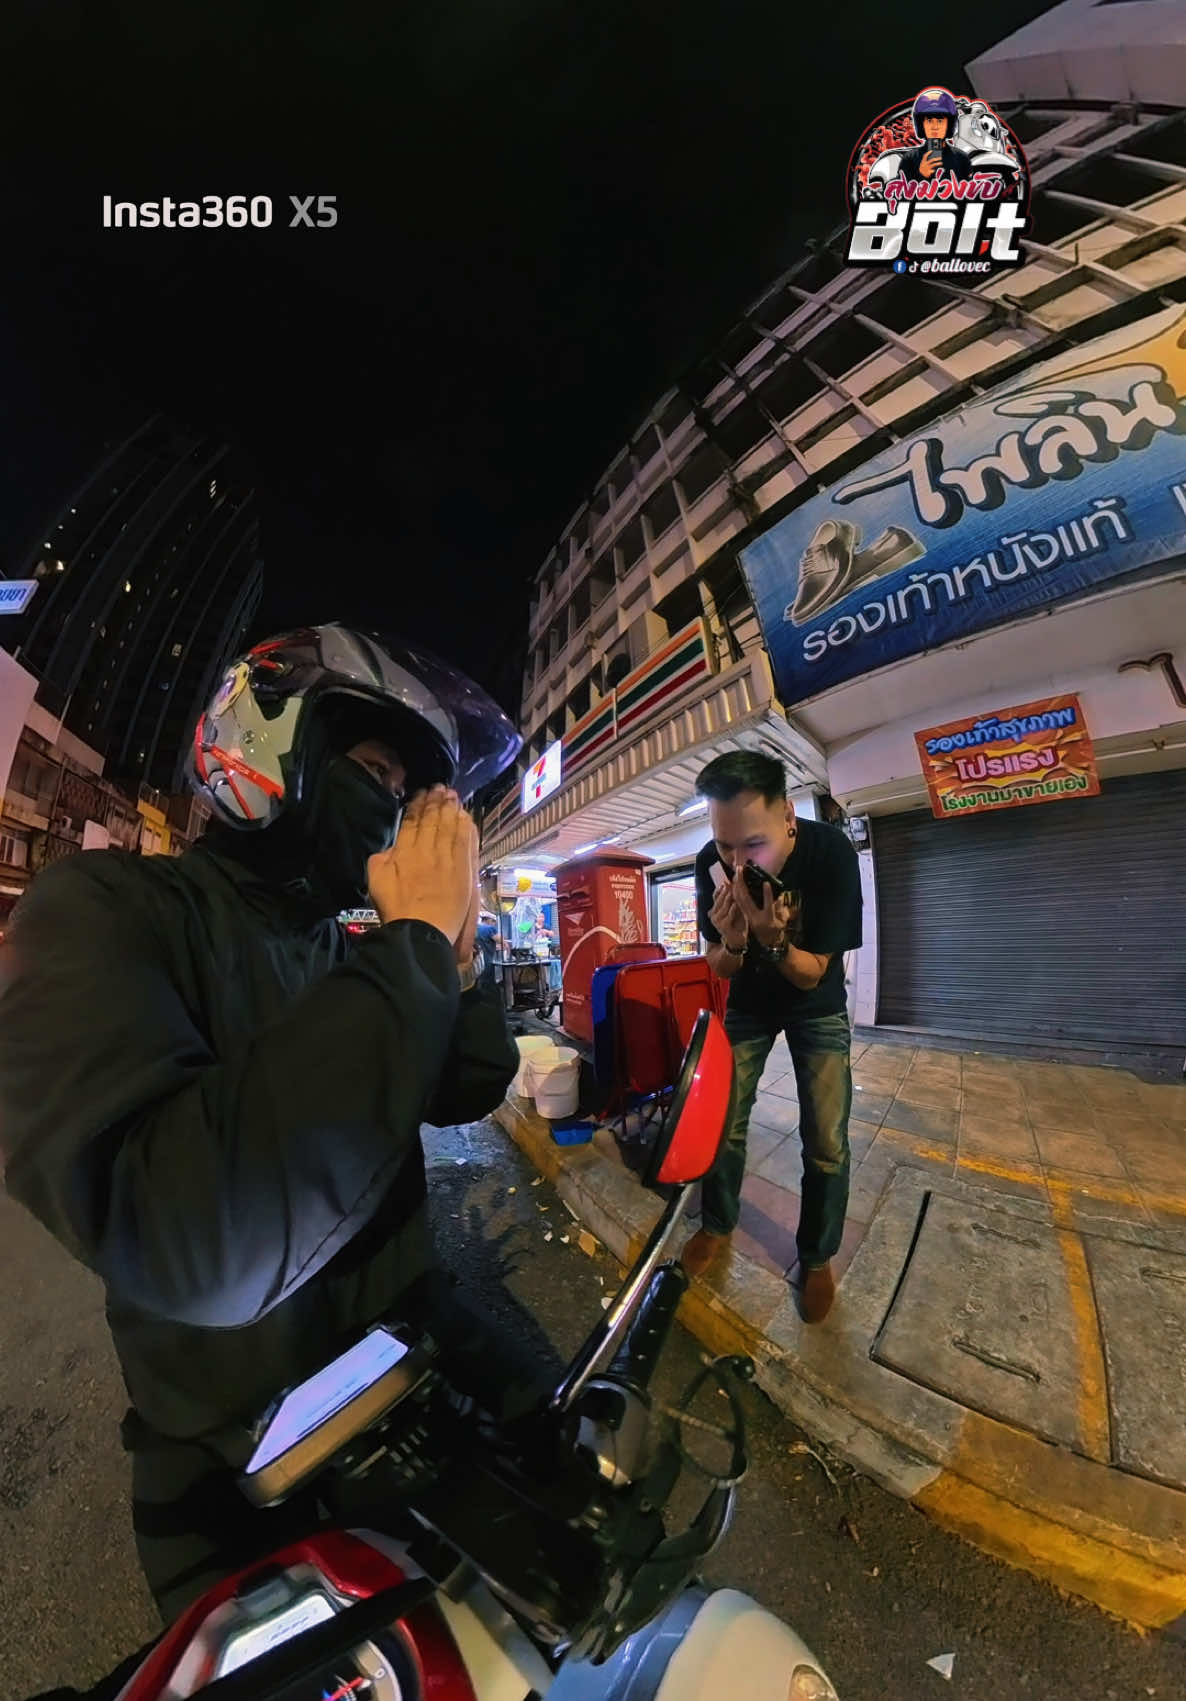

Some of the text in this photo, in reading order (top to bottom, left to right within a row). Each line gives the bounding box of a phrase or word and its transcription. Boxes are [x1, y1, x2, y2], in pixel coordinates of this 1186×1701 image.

[802, 499, 1128, 662] รองเท้าหนังแท้
[925, 707, 1074, 755] รองเท้าสุขภาพ
[955, 749, 1056, 781] โปรแรง
[940, 775, 1089, 812] โรงงานมาขายเอง
